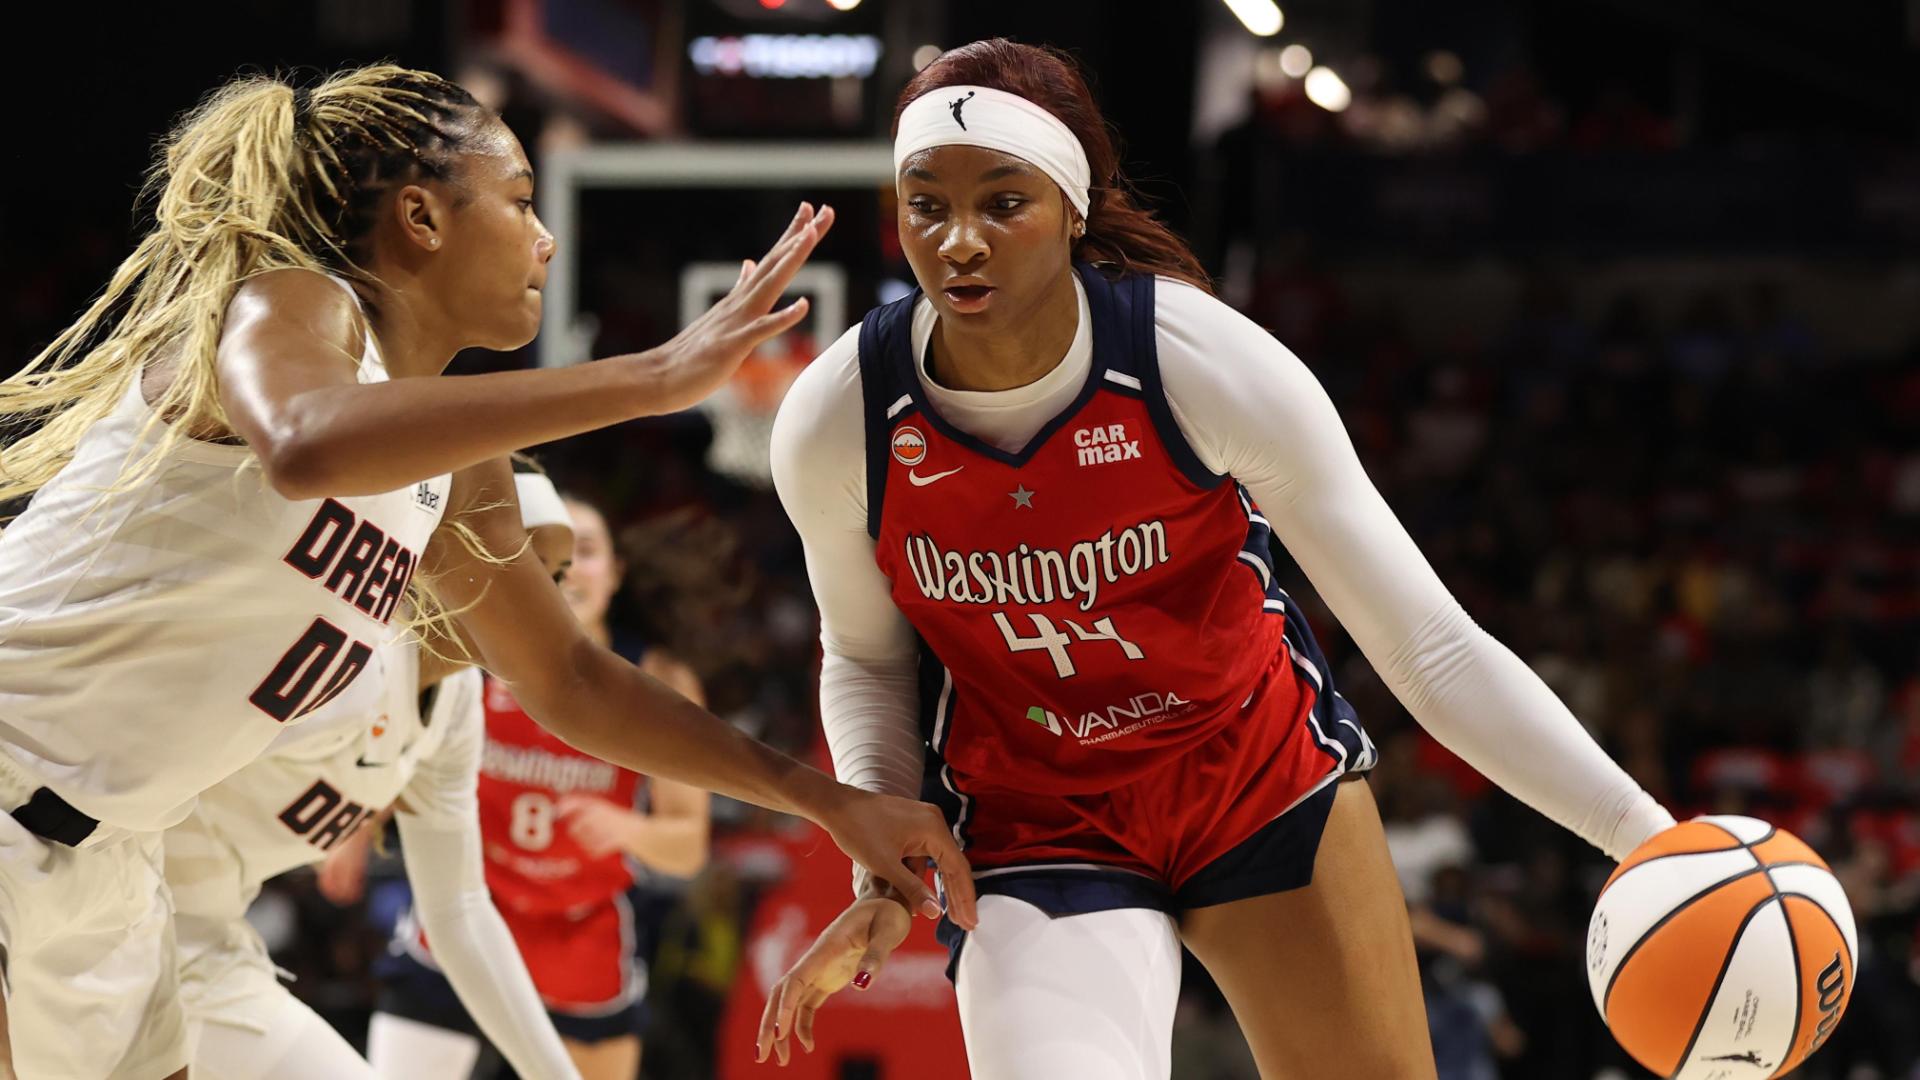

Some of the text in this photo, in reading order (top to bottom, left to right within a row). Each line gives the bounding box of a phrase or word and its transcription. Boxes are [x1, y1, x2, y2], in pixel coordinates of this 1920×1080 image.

[1074, 424, 1125, 447] CAR
[1077, 440, 1142, 467] max
[283, 497, 417, 626] DREA
[905, 519, 1170, 611] Washington
[992, 611, 1145, 679] 44
[1063, 692, 1190, 738] VANDA
[509, 791, 554, 850] 8
